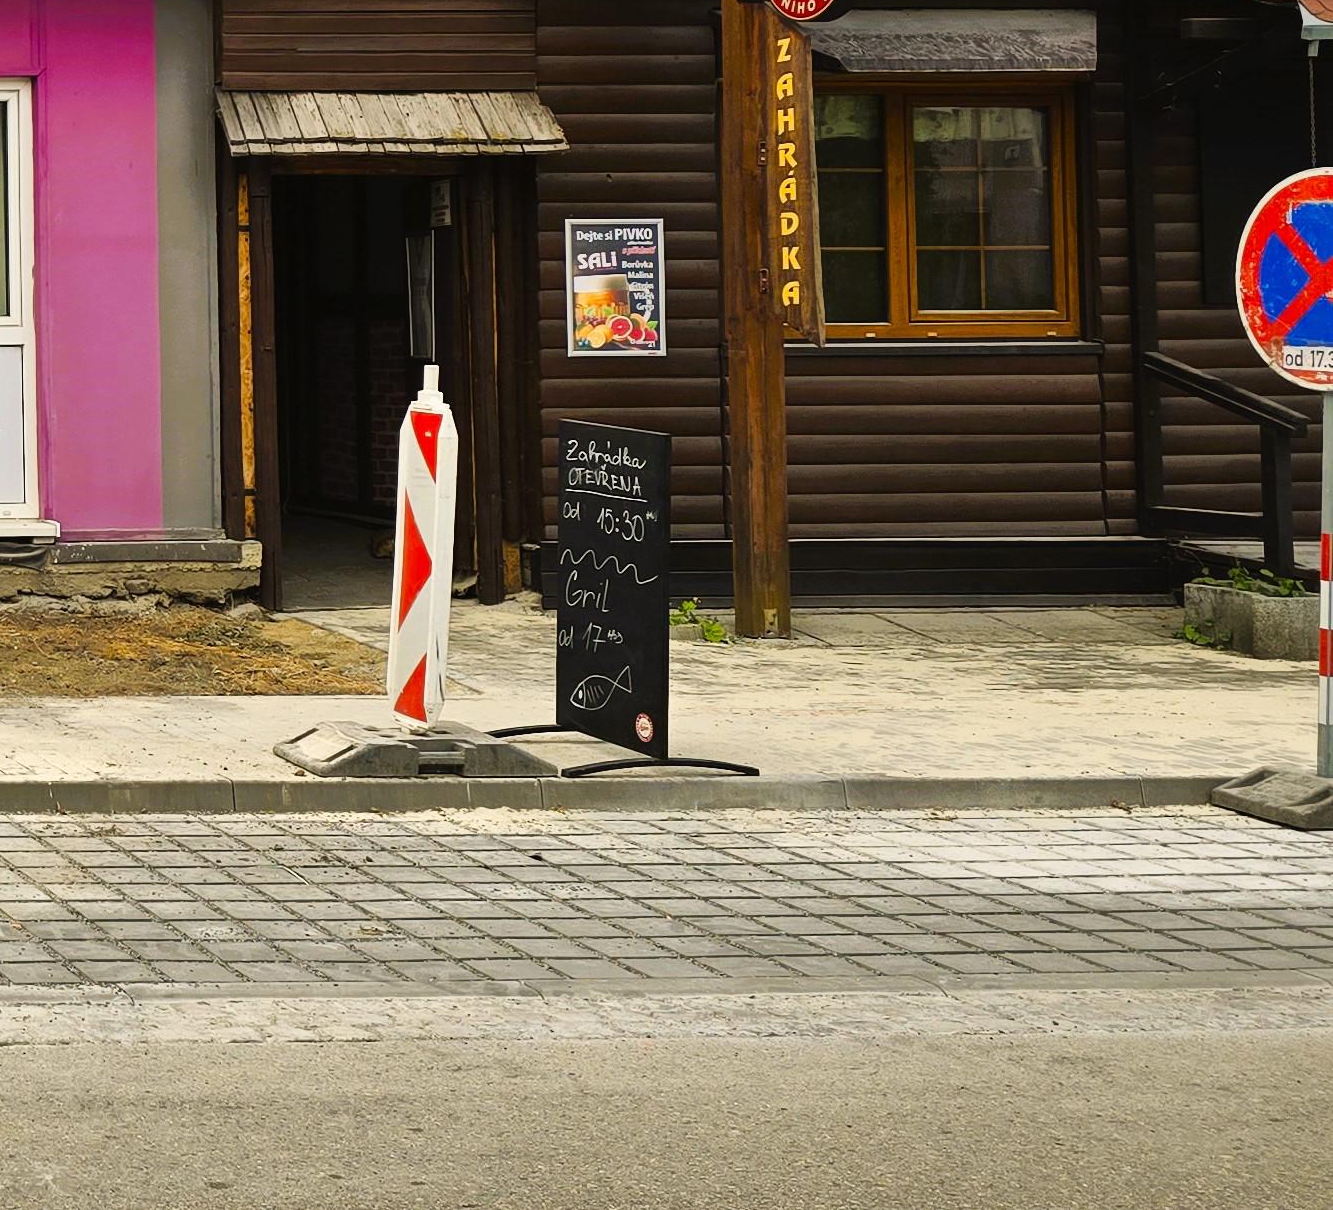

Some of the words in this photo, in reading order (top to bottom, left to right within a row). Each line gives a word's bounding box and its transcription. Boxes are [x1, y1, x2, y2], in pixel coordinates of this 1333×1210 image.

[777, 38, 801, 307] ZAHRÁDKA
[576, 231, 604, 242] Dejte
[604, 231, 613, 241] si
[614, 228, 653, 241] PIVKO
[1286, 350, 1303, 366] od
[566, 440, 647, 469] Zahrádka
[569, 464, 641, 496] OTEVŘENA
[597, 508, 645, 542] 15:30
[583, 622, 606, 653] 17
